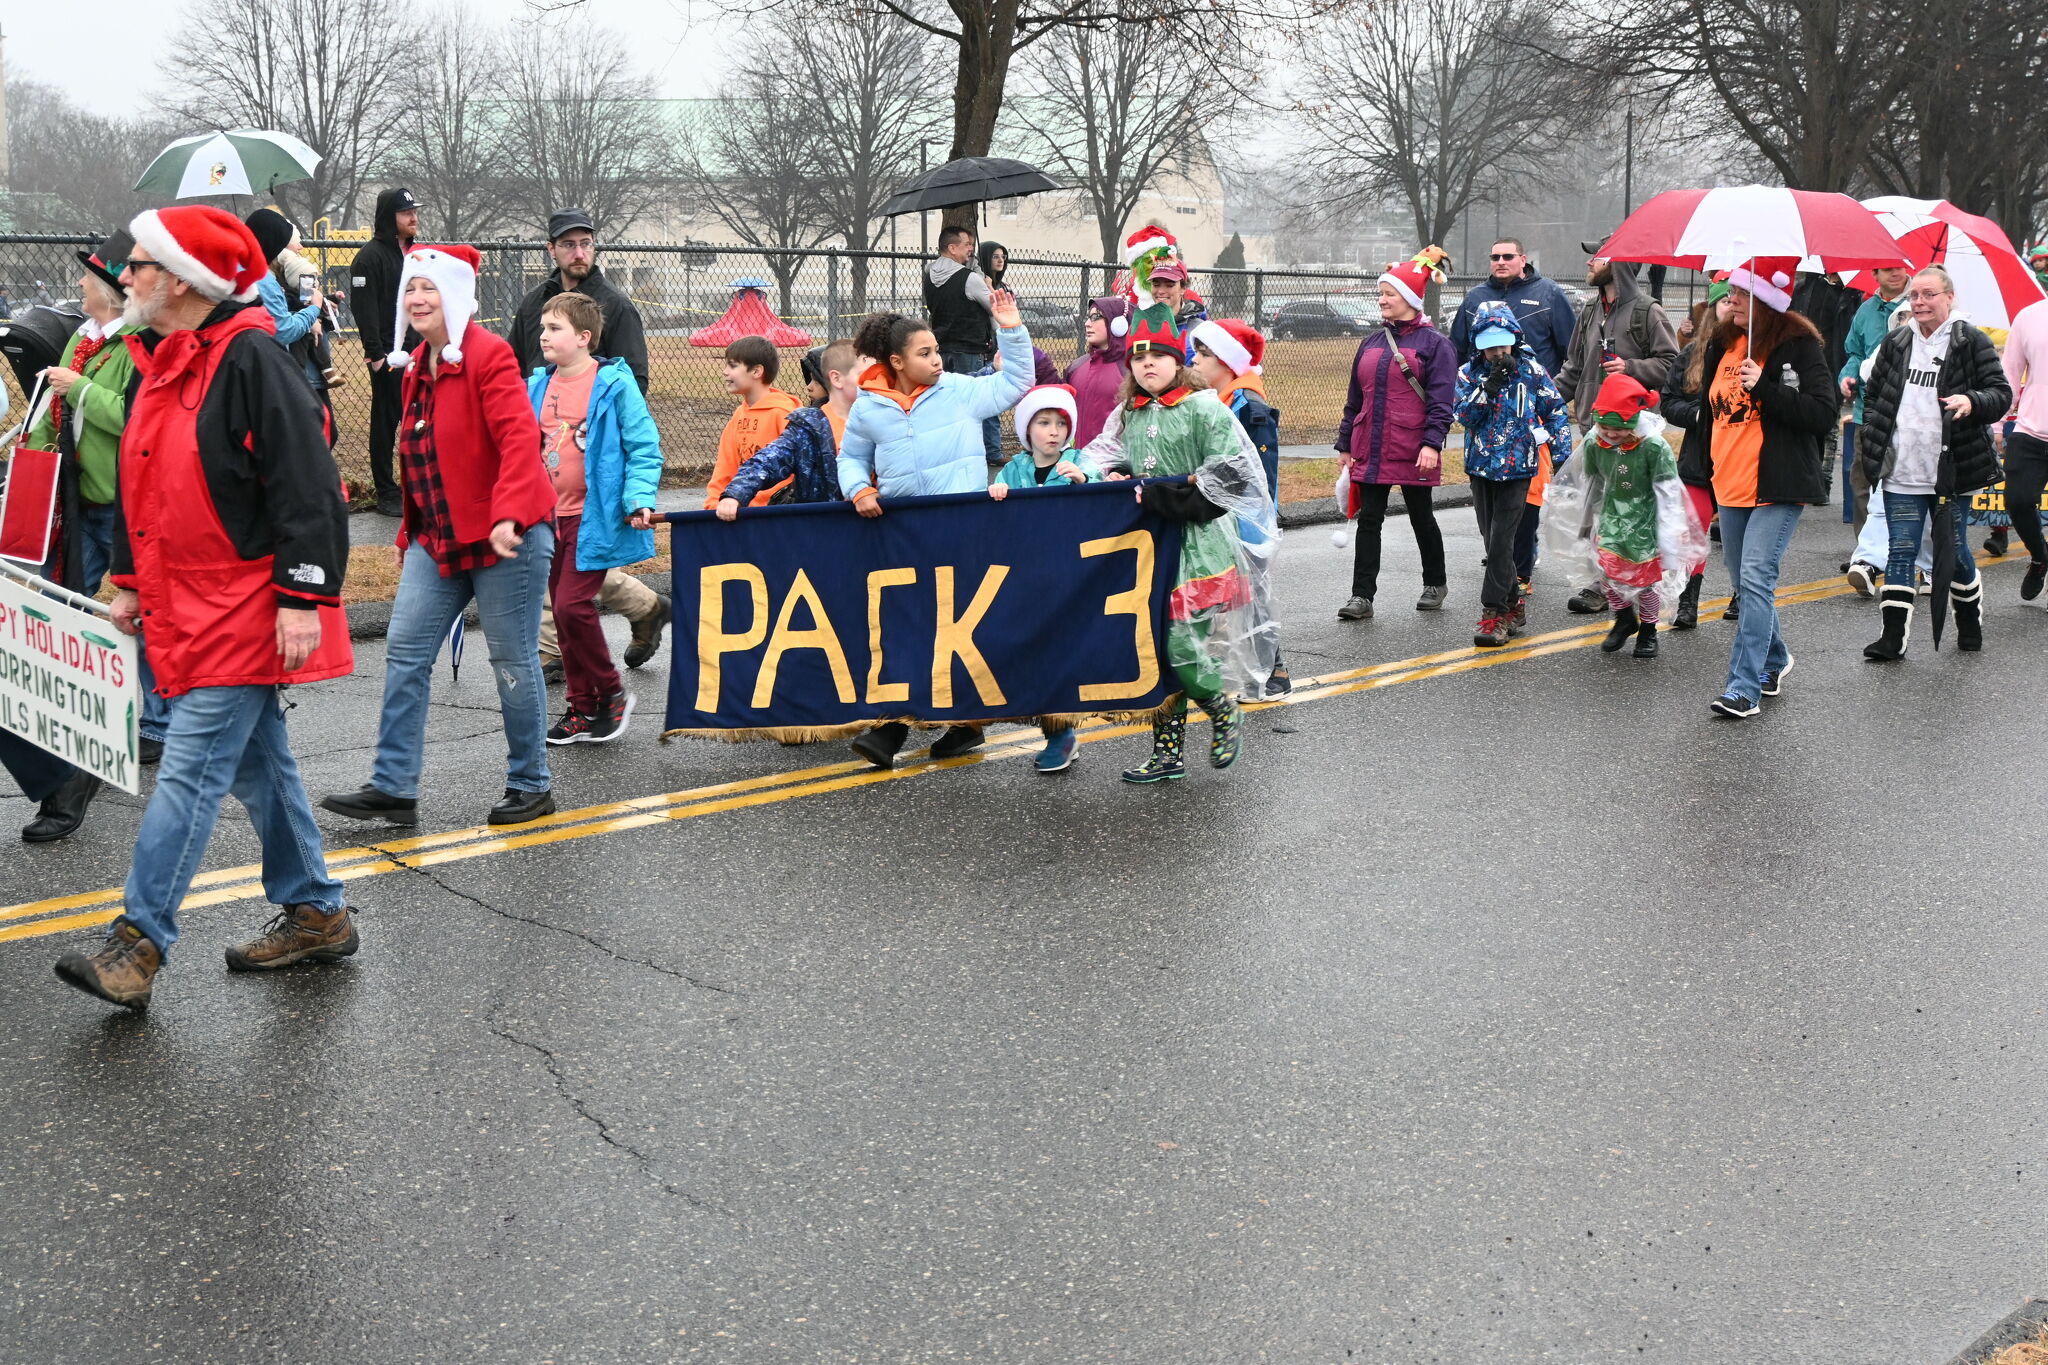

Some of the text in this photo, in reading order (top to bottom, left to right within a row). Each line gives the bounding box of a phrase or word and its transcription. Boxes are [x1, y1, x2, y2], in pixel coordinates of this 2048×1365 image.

[1723, 366, 1743, 377] PAC
[25, 614, 125, 688] HOLIDAYS
[695, 529, 1161, 713] PACK 3
[0, 648, 107, 729] ORRINGTON
[0, 693, 127, 786] ILS NETWORK
